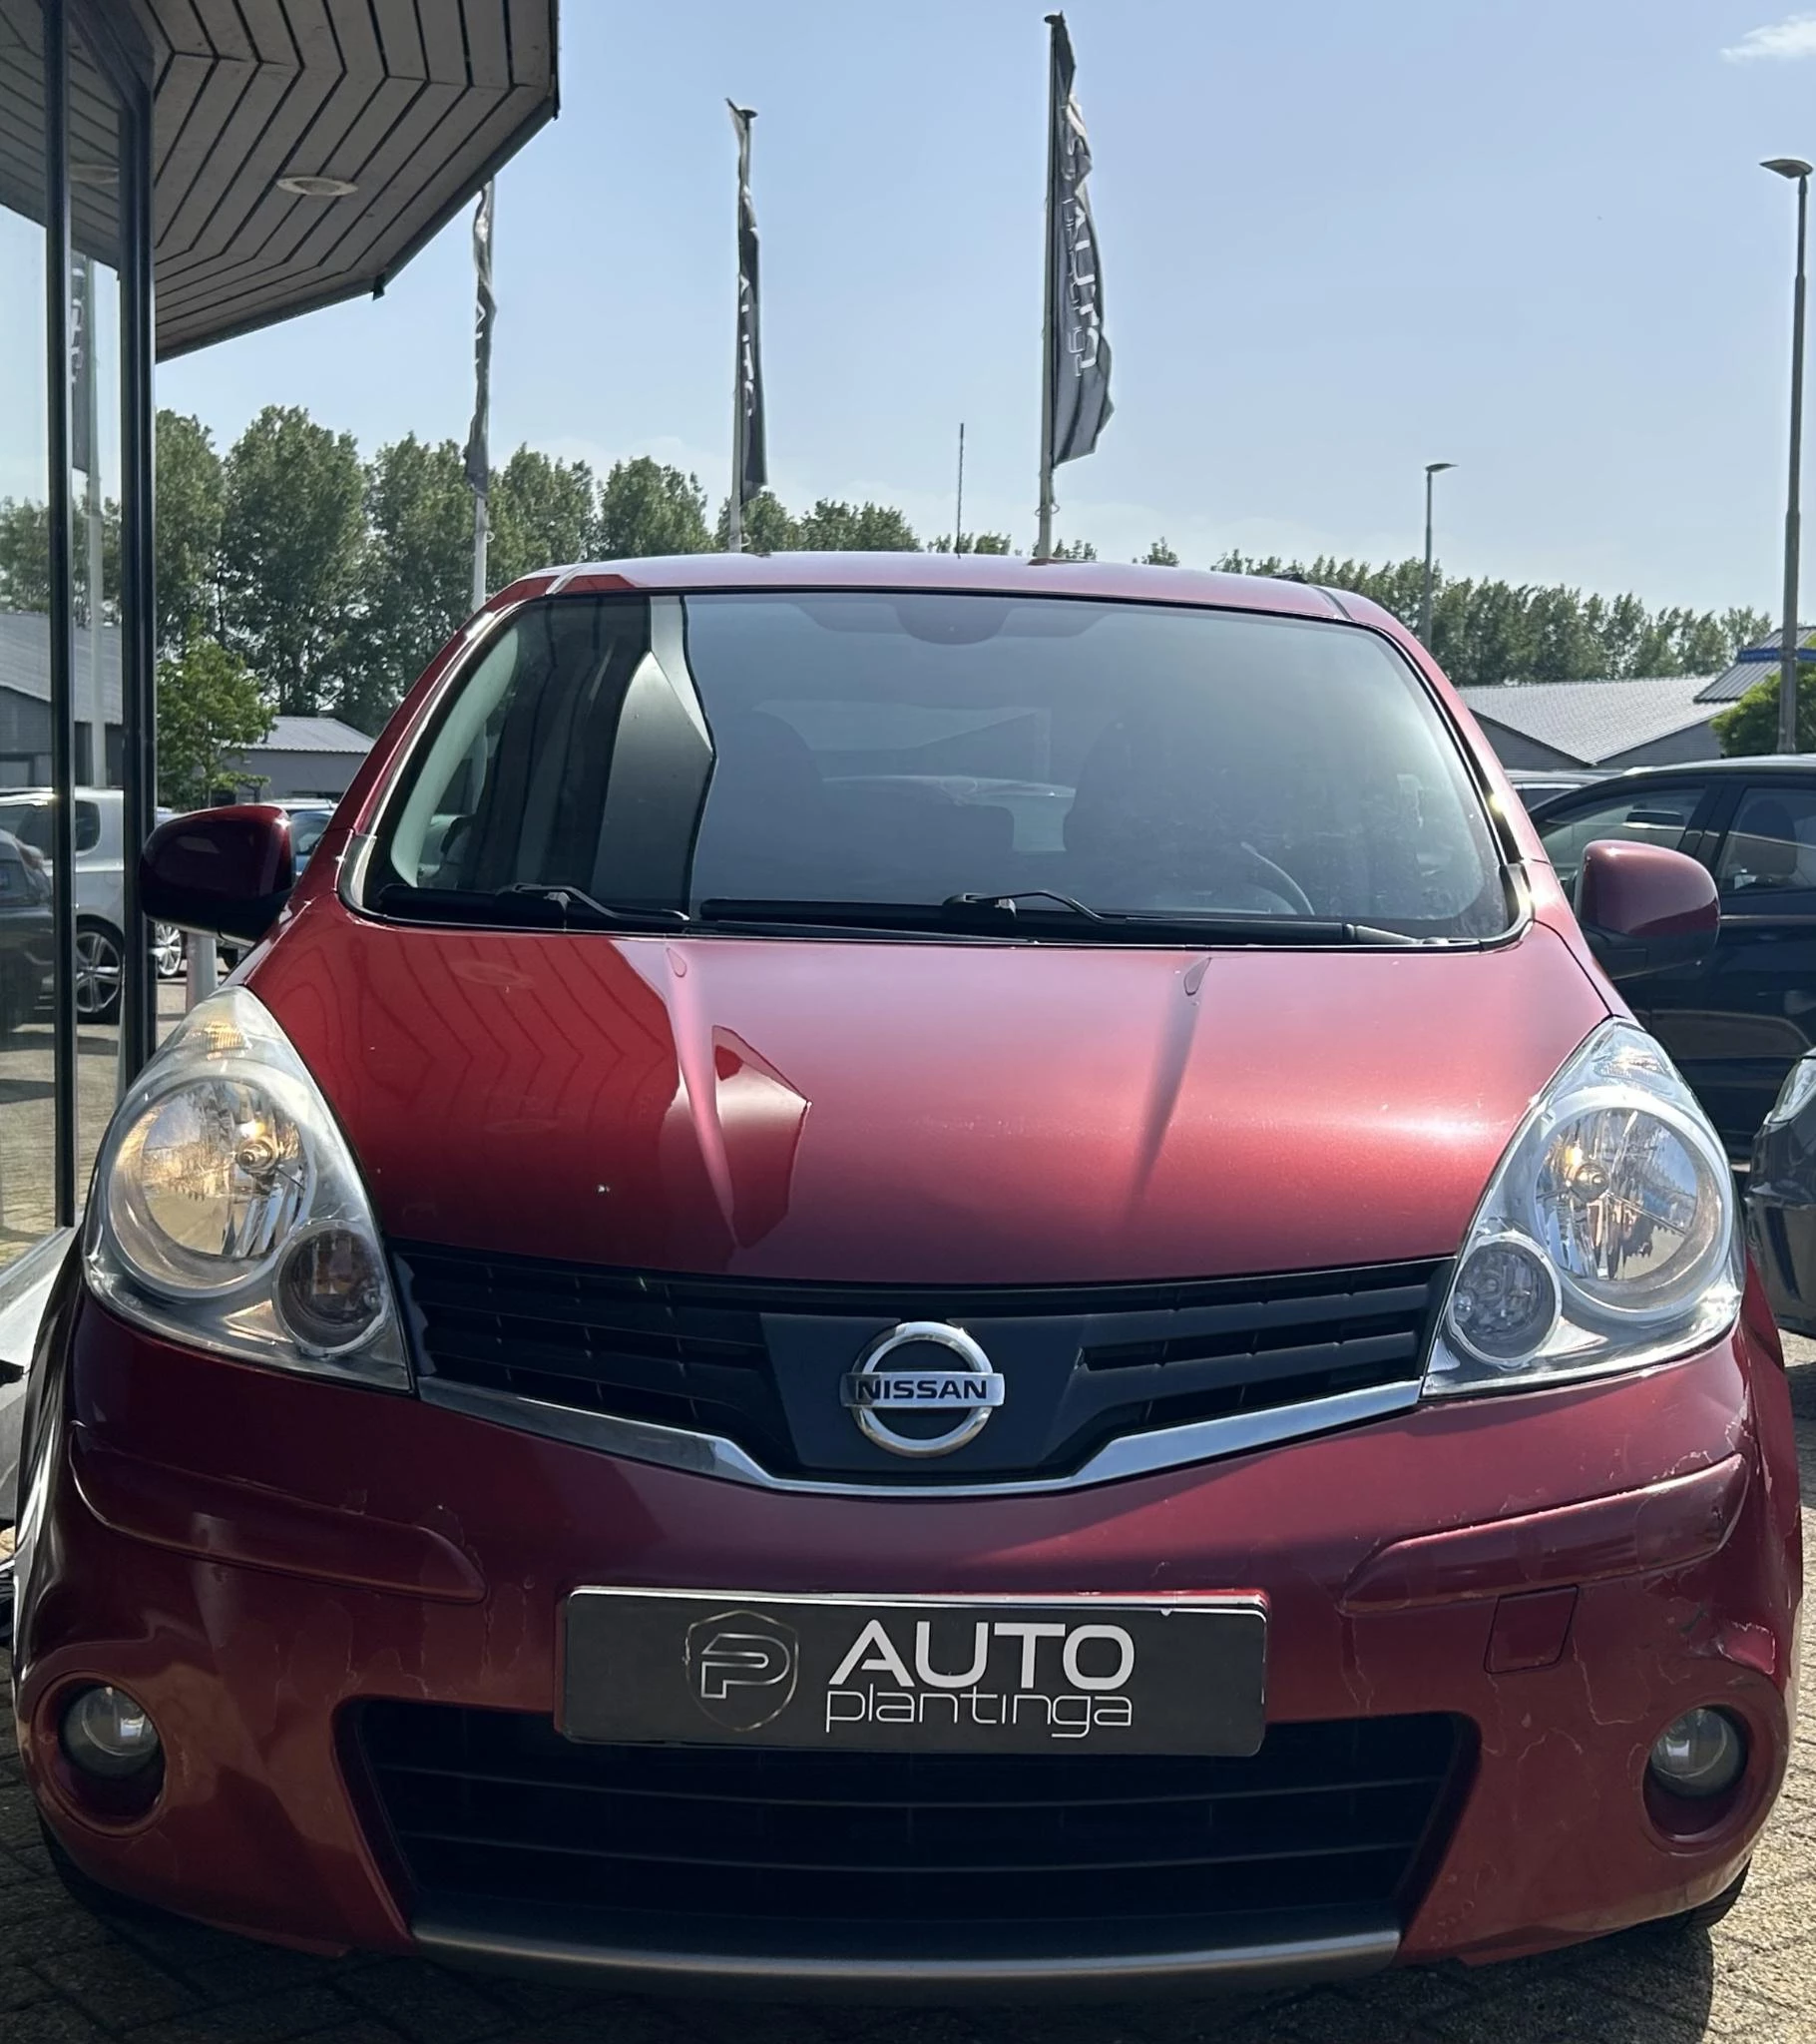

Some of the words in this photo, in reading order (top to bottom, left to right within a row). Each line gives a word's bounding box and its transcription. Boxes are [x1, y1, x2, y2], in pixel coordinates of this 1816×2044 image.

[856, 1379, 988, 1400] NISSAN
[828, 1619, 1135, 1691] AUTO
[825, 1683, 1134, 1739] plantinga
